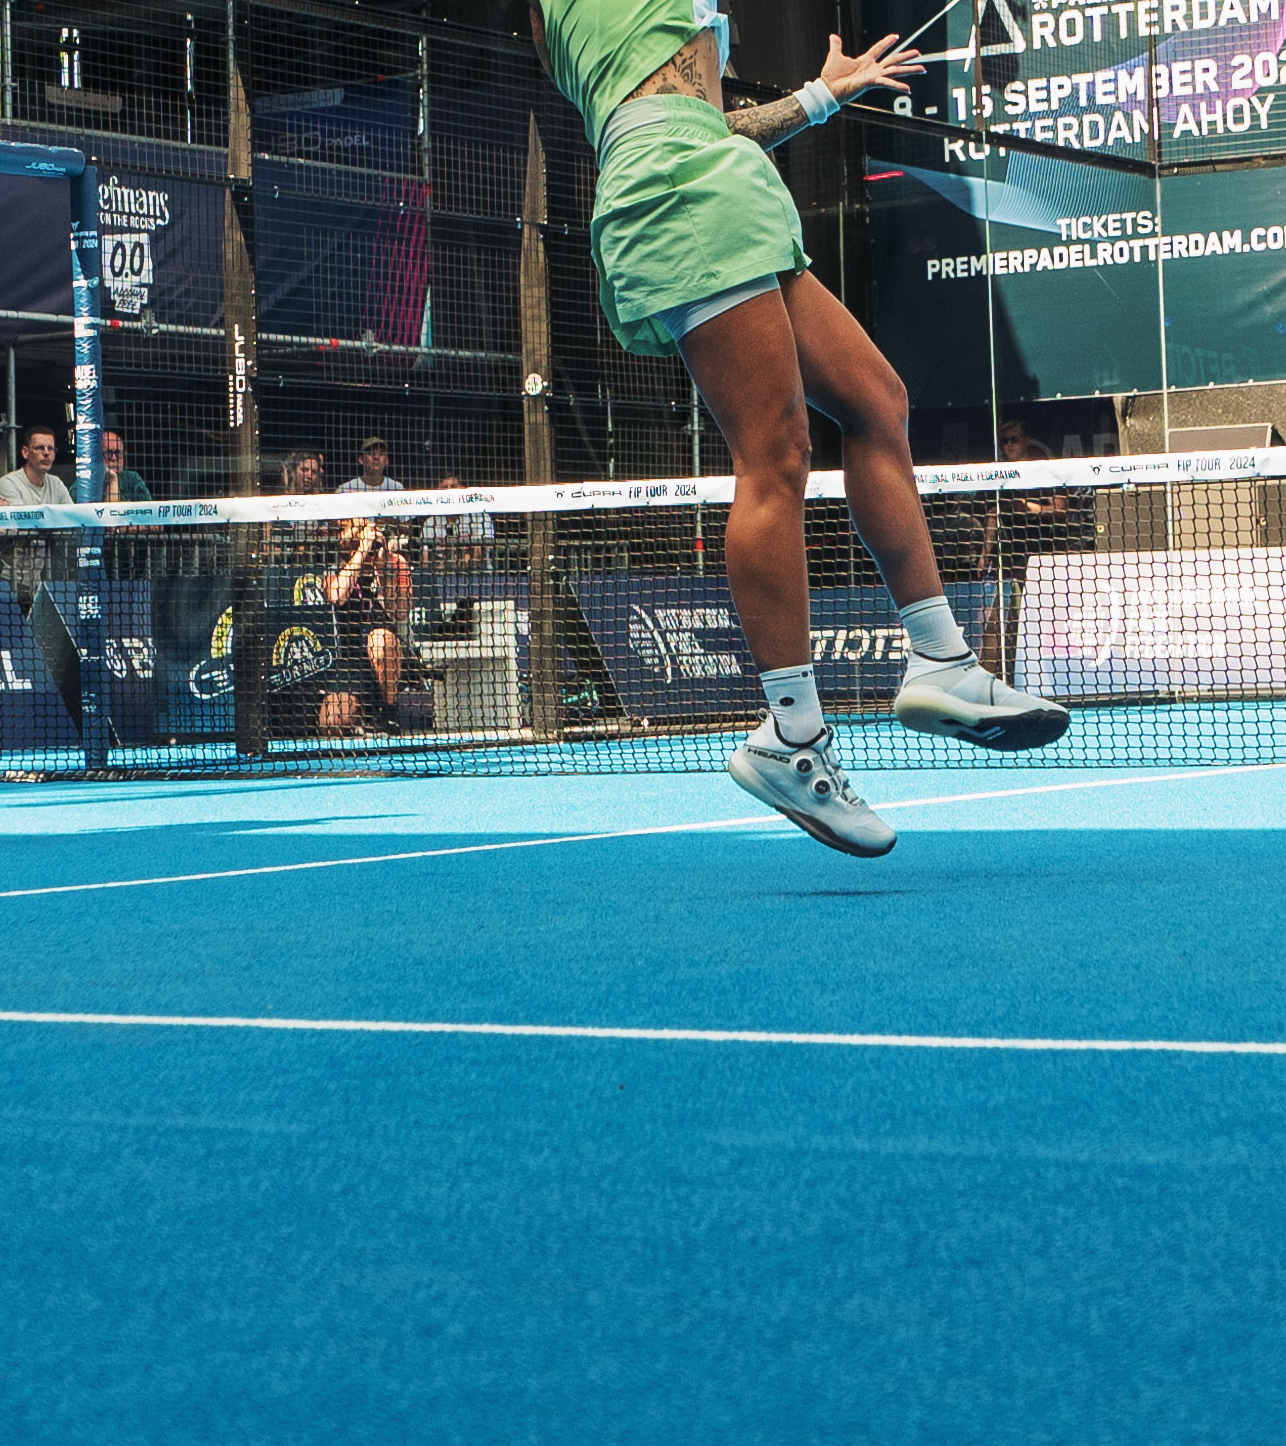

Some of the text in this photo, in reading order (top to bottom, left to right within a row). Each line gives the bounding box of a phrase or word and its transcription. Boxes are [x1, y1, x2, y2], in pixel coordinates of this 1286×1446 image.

[952, 84, 993, 121] 15
[1004, 58, 1219, 116] SEPTEMBER
[1174, 93, 1276, 139] AHOY
[100, 213, 155, 230] ON THE ROCKS
[1057, 210, 1161, 242] TICKETS:
[110, 241, 144, 278] 0.0
[234, 324, 246, 393] JUBO
[109, 508, 153, 518] CUPRA
[158, 505, 171, 519] FIP
[172, 505, 192, 518] TOUR
[199, 503, 218, 518] 2024
[628, 485, 643, 499] FIP
[674, 483, 697, 497] 2024
[1108, 462, 1169, 473] CUPRA
[1177, 459, 1192, 473] FIP
[1195, 457, 1221, 471] TOUR
[1229, 455, 1256, 470] 2024
[746, 746, 791, 763] HEAD
